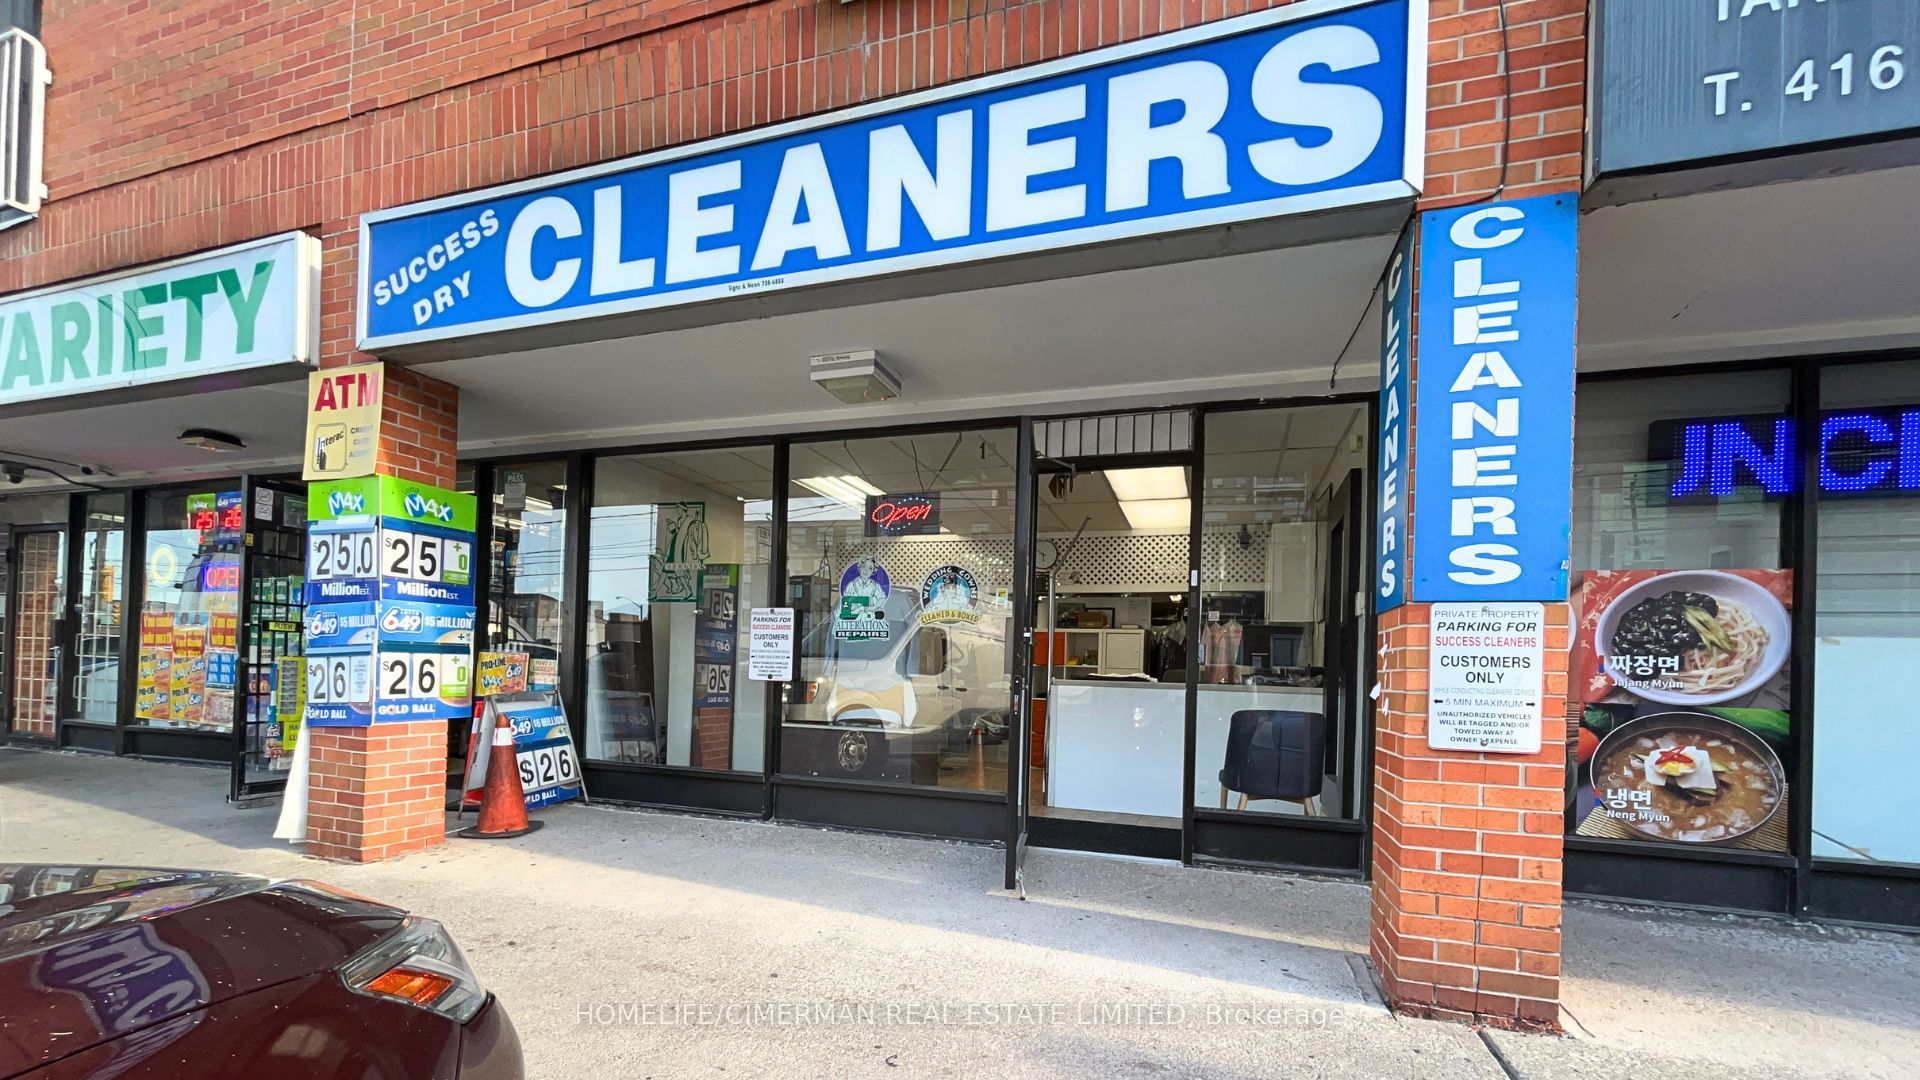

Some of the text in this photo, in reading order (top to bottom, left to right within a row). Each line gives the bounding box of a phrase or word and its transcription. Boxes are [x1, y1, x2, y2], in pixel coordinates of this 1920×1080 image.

[1703, 44, 1905, 116] T. 416
[505, 24, 1383, 308] CLEANERS
[373, 208, 500, 306] SUCCESS
[412, 270, 473, 326] DRY
[0, 259, 276, 391] ARIETY
[314, 371, 379, 411] ATM
[1448, 206, 1526, 586] CLEANERS
[1381, 252, 1403, 598] CLEANERS
[507, 475, 524, 483] PASS
[328, 491, 364, 516] MAX
[404, 494, 451, 522] MAX
[195, 511, 214, 530] 25
[224, 510, 243, 528] 26
[872, 503, 932, 528] Open
[385, 538, 437, 577] $25
[206, 567, 240, 588] OPE
[923, 567, 977, 599] WEDDING GOWNS
[321, 582, 360, 597] Million
[397, 581, 460, 601] Million EST.
[382, 608, 421, 633] 649
[436, 616, 472, 629] MILLION
[921, 611, 950, 624] CLEANED
[957, 611, 979, 622] BOXED
[1434, 610, 1539, 618] PRIVATE PROPERTY
[310, 613, 337, 635] 649
[835, 619, 889, 631] ALTERATIONS
[1437, 622, 1537, 632] PARKING FOR
[1435, 636, 1537, 647] SUCCESS CLEANERS
[480, 657, 507, 670] PRO-LINE
[505, 663, 523, 678] 649
[1440, 655, 1531, 668] CUSTOMERS
[1610, 655, 1681, 676] 짜장면
[309, 661, 346, 699] $26
[383, 658, 435, 695] $26
[1465, 671, 1504, 683] ONLY
[1611, 678, 1684, 690] Jajang Myun
[412, 703, 436, 714] BALL
[1453, 698, 1471, 706] MIN
[1475, 699, 1523, 708] MAXIMUM
[331, 709, 347, 719] BALL
[1437, 711, 1496, 719] UNAUTHORIZED
[510, 718, 531, 736] 649
[1485, 737, 1518, 745] EXPENSE
[519, 749, 571, 787] $26
[541, 789, 557, 801] BALL
[1606, 788, 1652, 810] 냉면
[1606, 810, 1670, 823] Neng Myun
